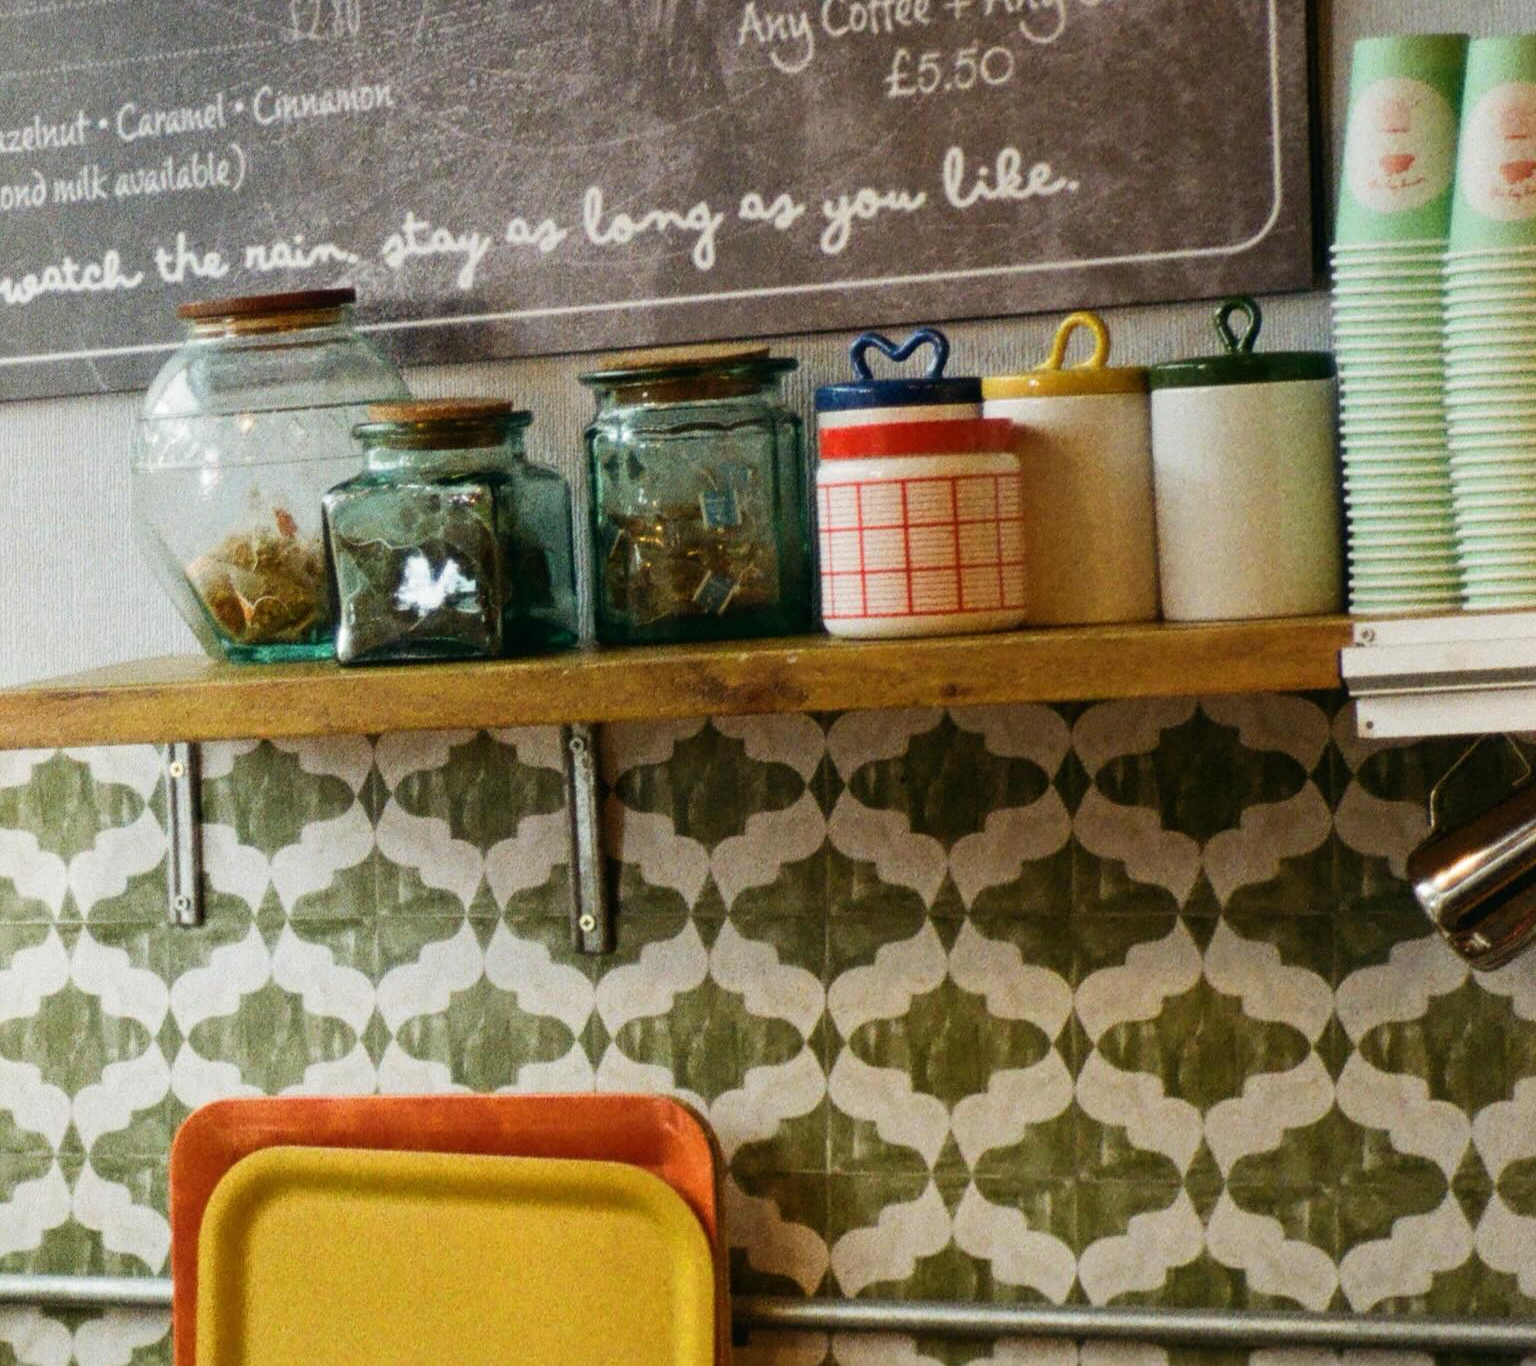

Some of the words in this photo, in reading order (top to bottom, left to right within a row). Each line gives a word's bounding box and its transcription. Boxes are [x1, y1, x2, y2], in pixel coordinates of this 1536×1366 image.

[738, 1, 814, 74] Any
[886, 41, 1015, 99] £5.50
[116, 95, 226, 142] Caramel
[252, 83, 395, 126] Cinnamon
[54, 164, 107, 203] milk
[115, 143, 247, 196] available)
[154, 230, 231, 284] the
[382, 210, 491, 290] stay
[506, 216, 567, 254] as
[582, 185, 724, 272] long
[739, 192, 806, 230] as
[820, 187, 927, 255] you
[943, 146, 1080, 209] like.
